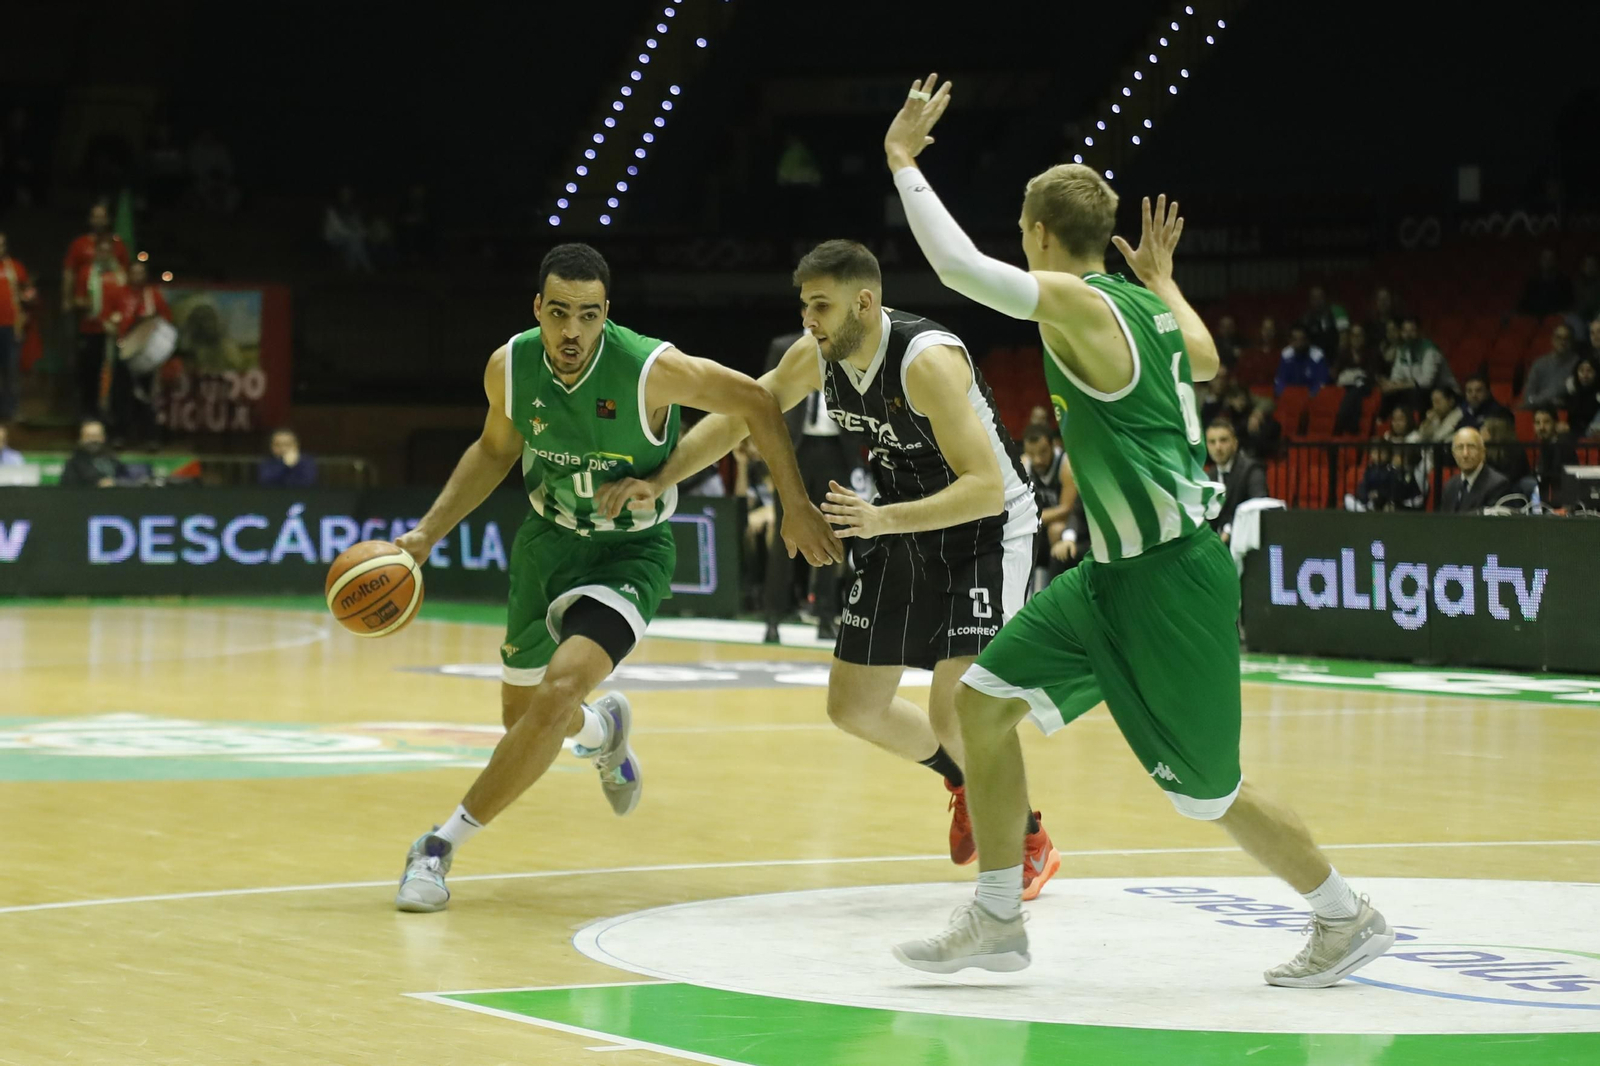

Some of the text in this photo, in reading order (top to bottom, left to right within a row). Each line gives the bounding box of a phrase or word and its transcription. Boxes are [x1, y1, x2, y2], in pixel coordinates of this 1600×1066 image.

[460, 520, 508, 571] LA
[341, 573, 390, 610] molten
[947, 626, 996, 637] EL CORREO
